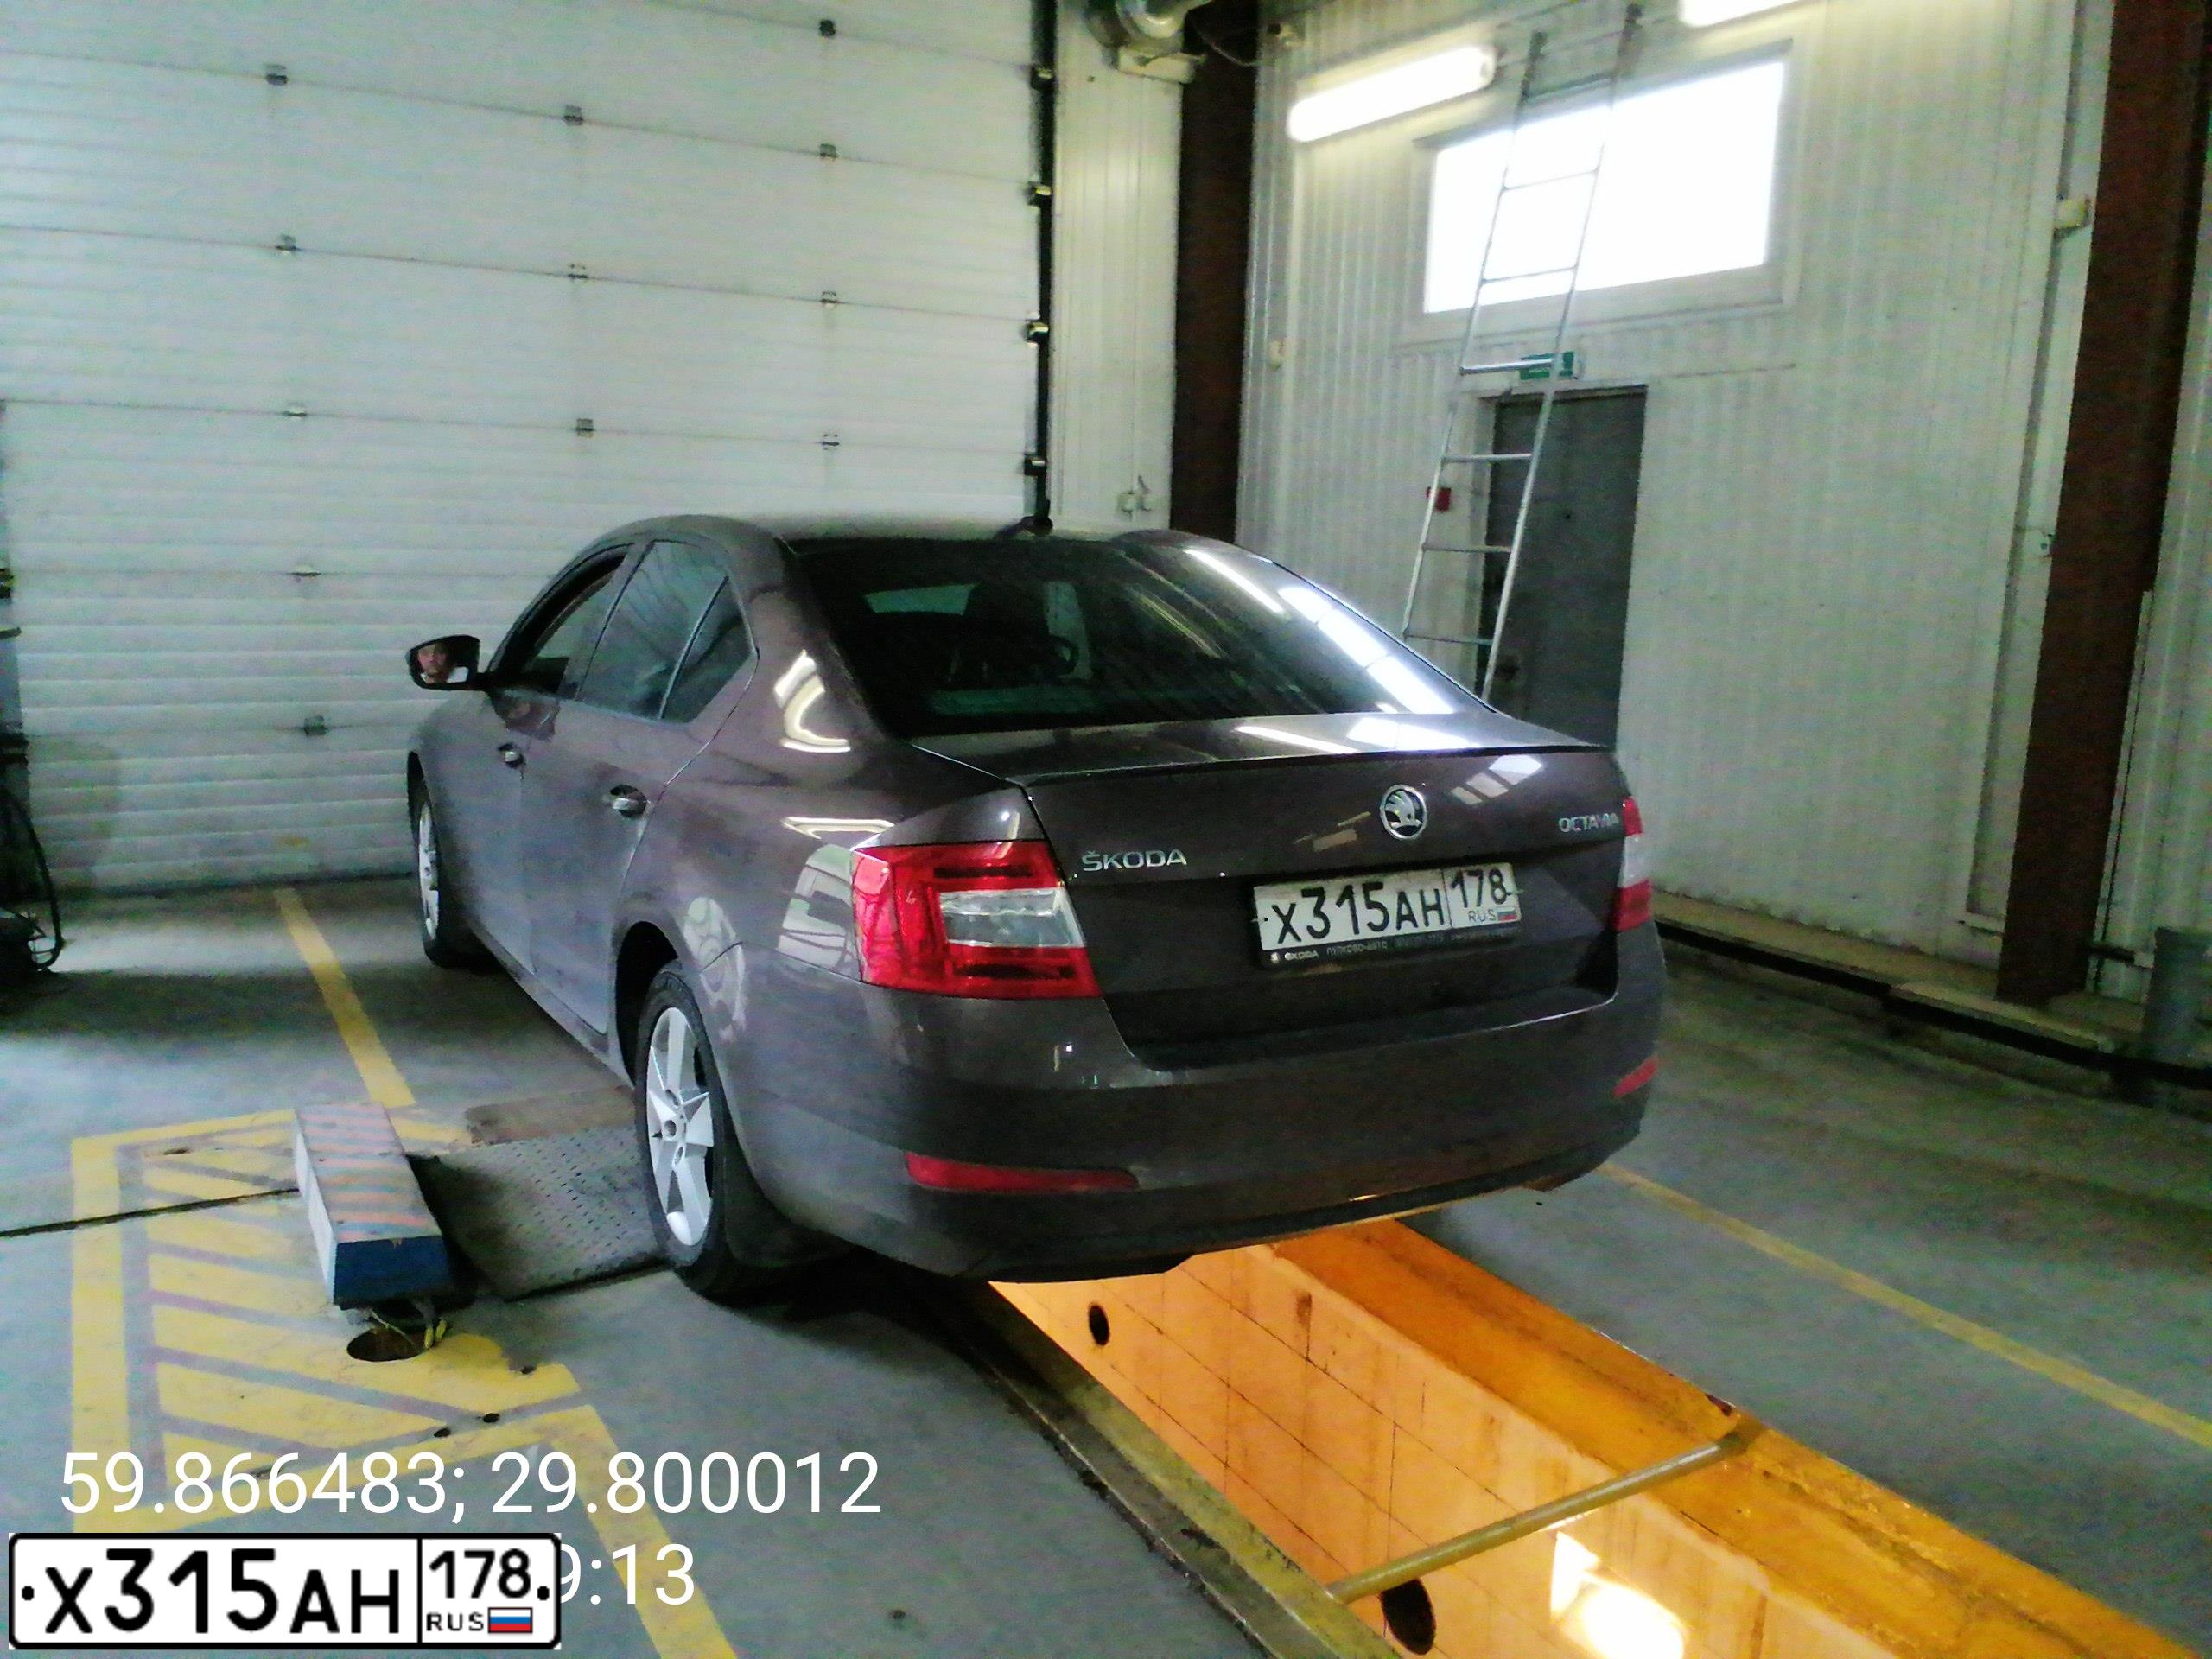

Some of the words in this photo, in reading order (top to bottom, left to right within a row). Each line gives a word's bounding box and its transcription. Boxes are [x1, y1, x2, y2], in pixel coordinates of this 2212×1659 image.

[1082, 849, 1188, 872] ŠKODA
[1451, 868, 1508, 908] 178
[1468, 908, 1497, 923] RUS
